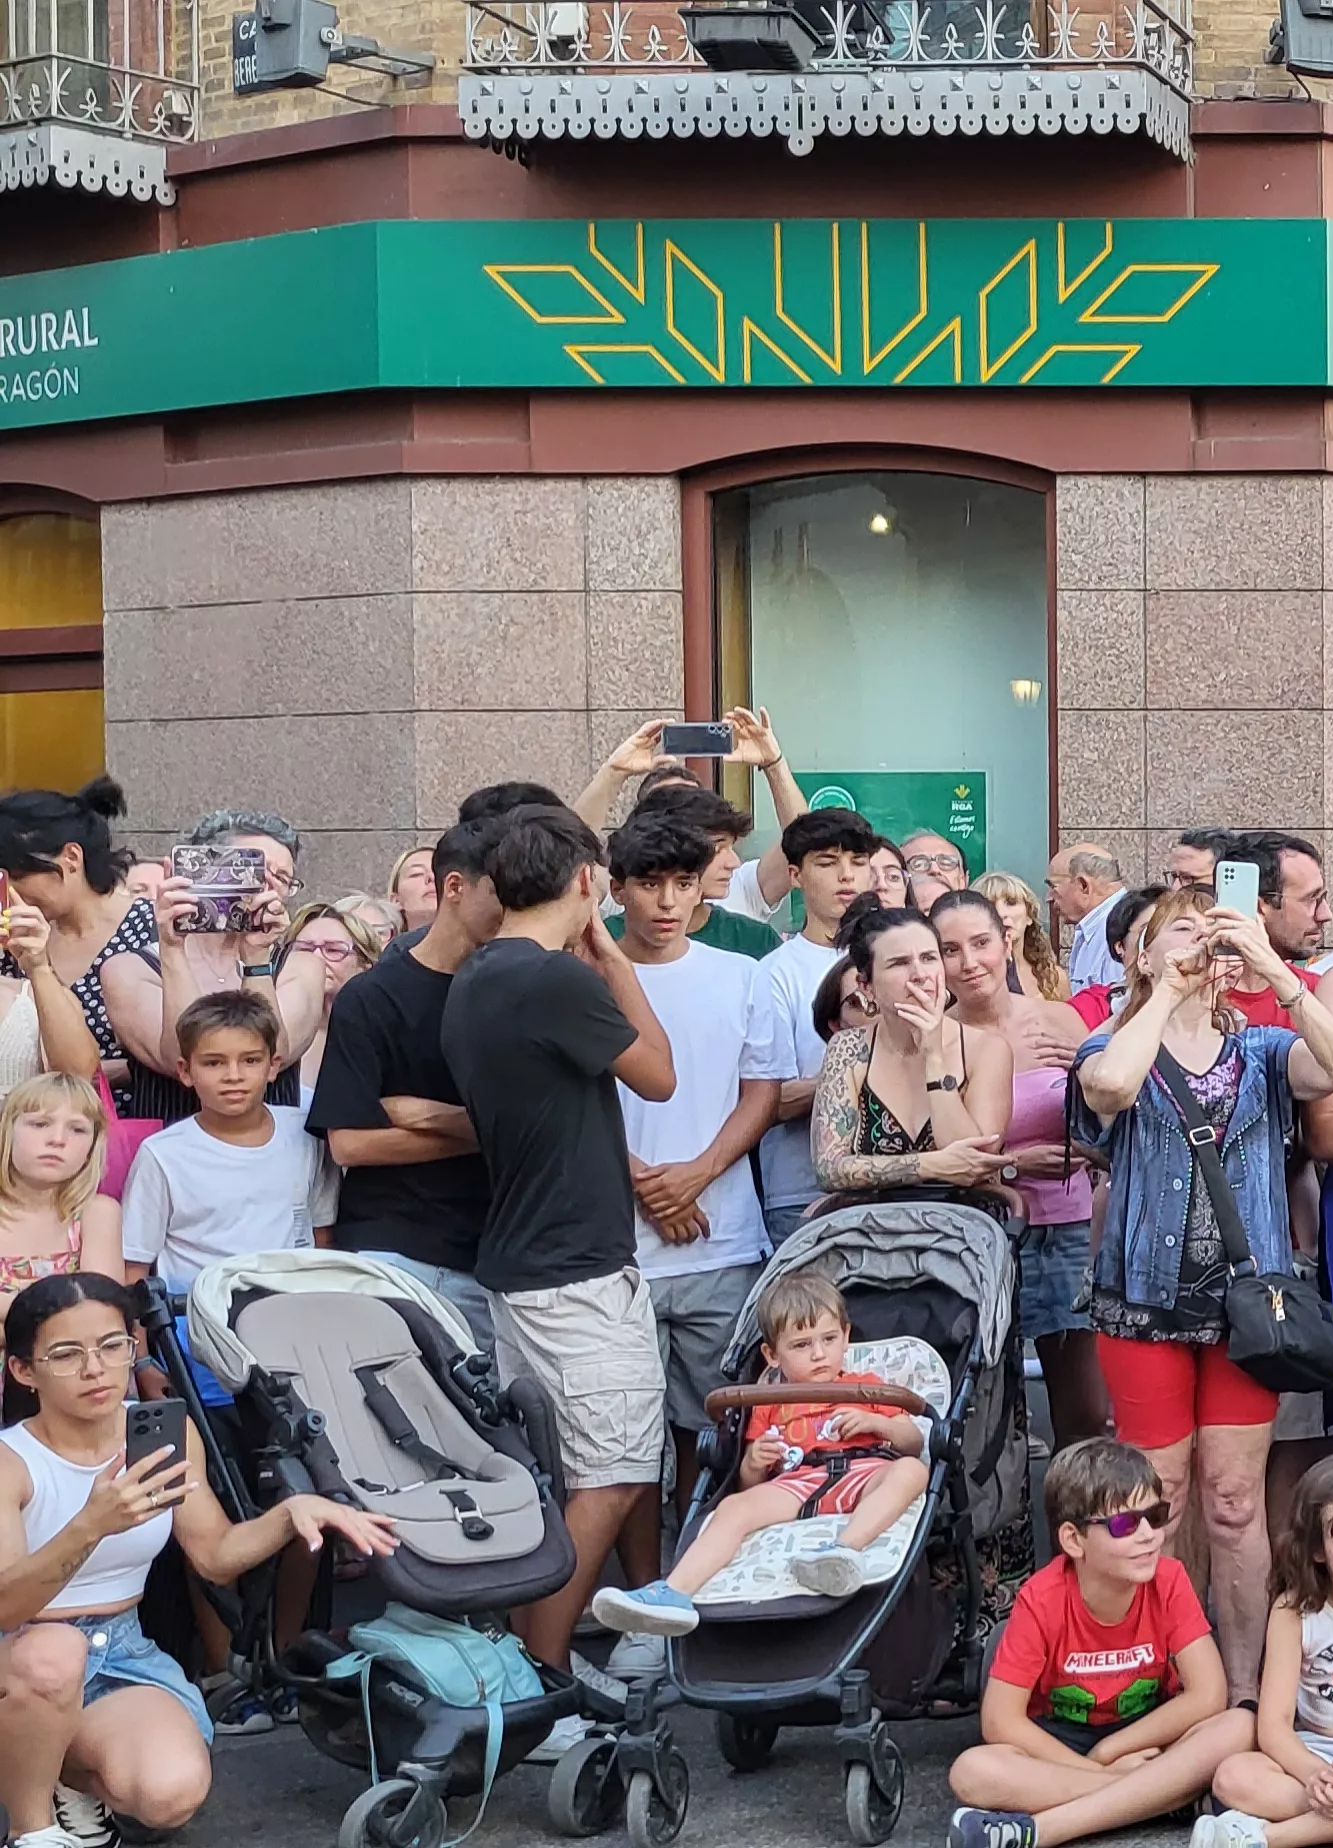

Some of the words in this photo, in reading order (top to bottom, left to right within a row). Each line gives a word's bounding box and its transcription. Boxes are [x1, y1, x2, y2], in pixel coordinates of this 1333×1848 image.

[239, 20, 257, 40] CA
[234, 55, 258, 88] BERE
[0, 307, 98, 357] RURAL
[0, 361, 79, 403] RAGÓN
[1065, 1644, 1154, 1672] MINECRAFT
